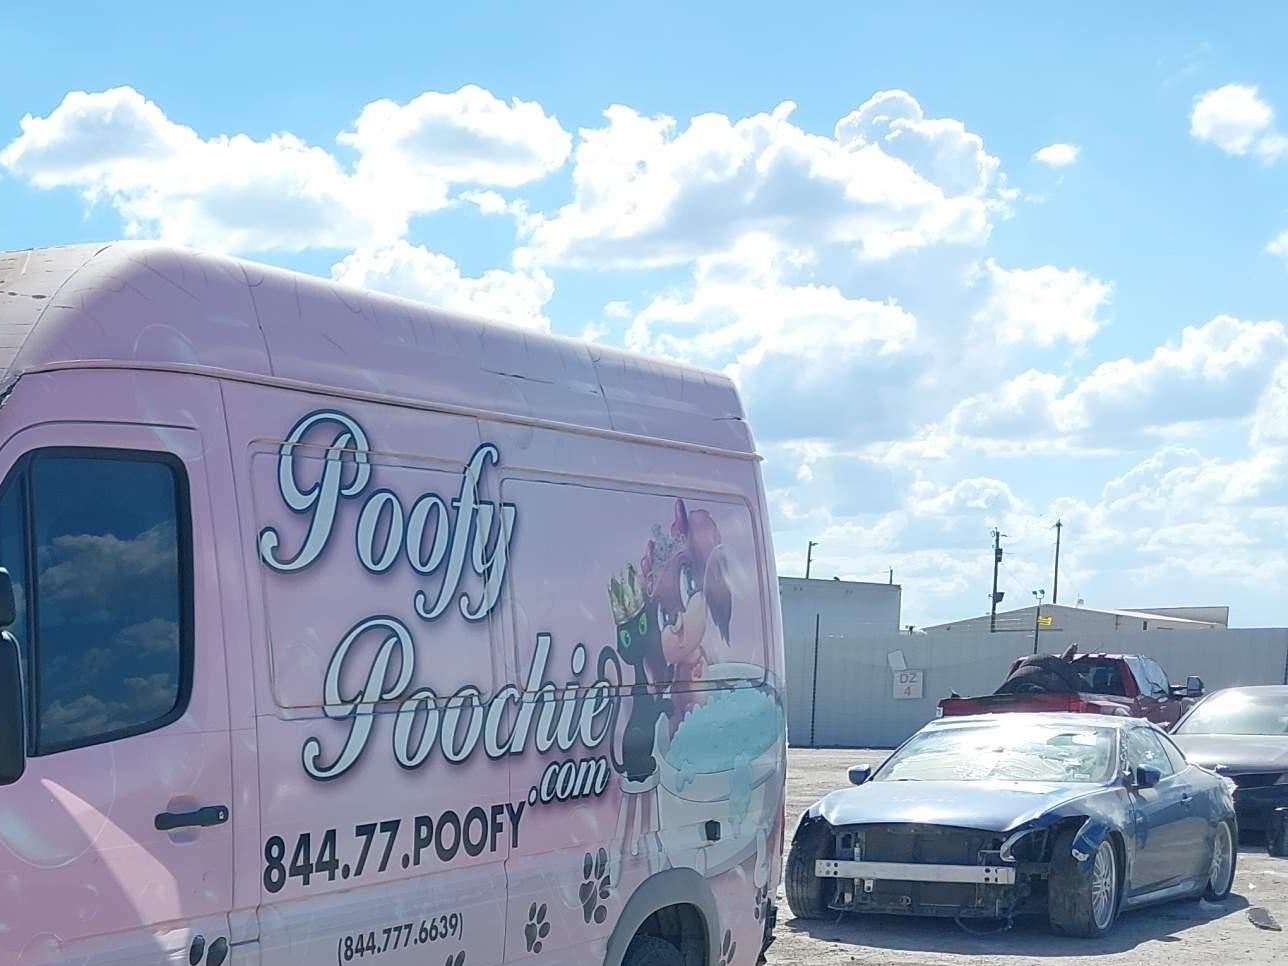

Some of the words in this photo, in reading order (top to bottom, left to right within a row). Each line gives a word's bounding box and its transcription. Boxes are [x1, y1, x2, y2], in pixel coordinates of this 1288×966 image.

[257, 408, 516, 622] Poofy
[302, 613, 614, 782] Poochie
[528, 755, 611, 804] .com
[263, 802, 524, 893] 844.77.POOFY
